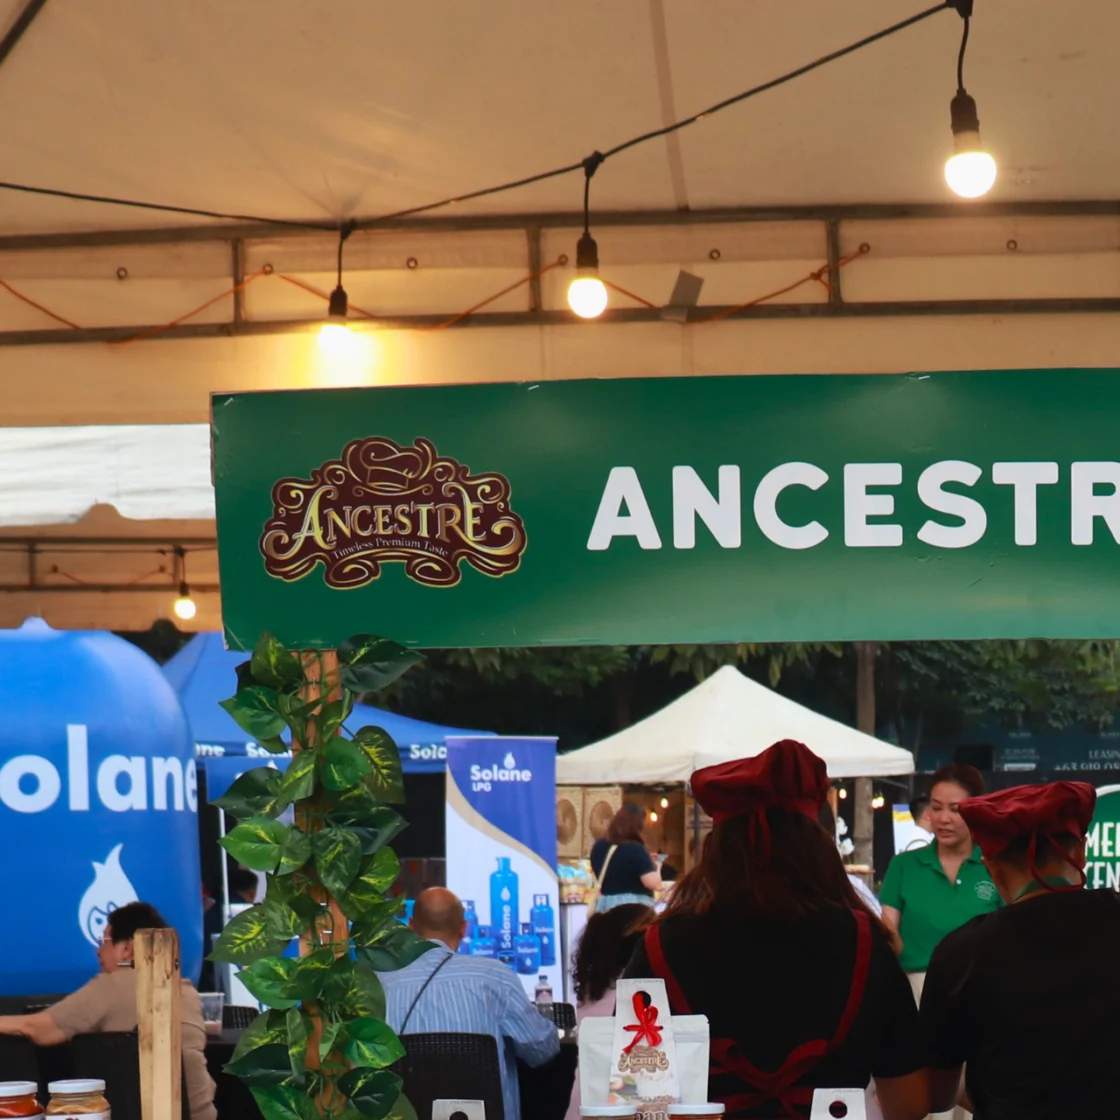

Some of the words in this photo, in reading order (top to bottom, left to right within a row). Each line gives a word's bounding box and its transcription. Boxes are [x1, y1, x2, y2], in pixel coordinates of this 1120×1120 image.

[278, 482, 504, 554] ANCESTRE
[332, 538, 374, 560] Timeless
[375, 537, 421, 550] Premium
[423, 540, 449, 558] Taste
[410, 744, 447, 759] Sola
[0, 724, 197, 813] olane
[470, 763, 532, 782] Solane
[472, 782, 492, 792] LPG
[501, 904, 511, 949] Solane
